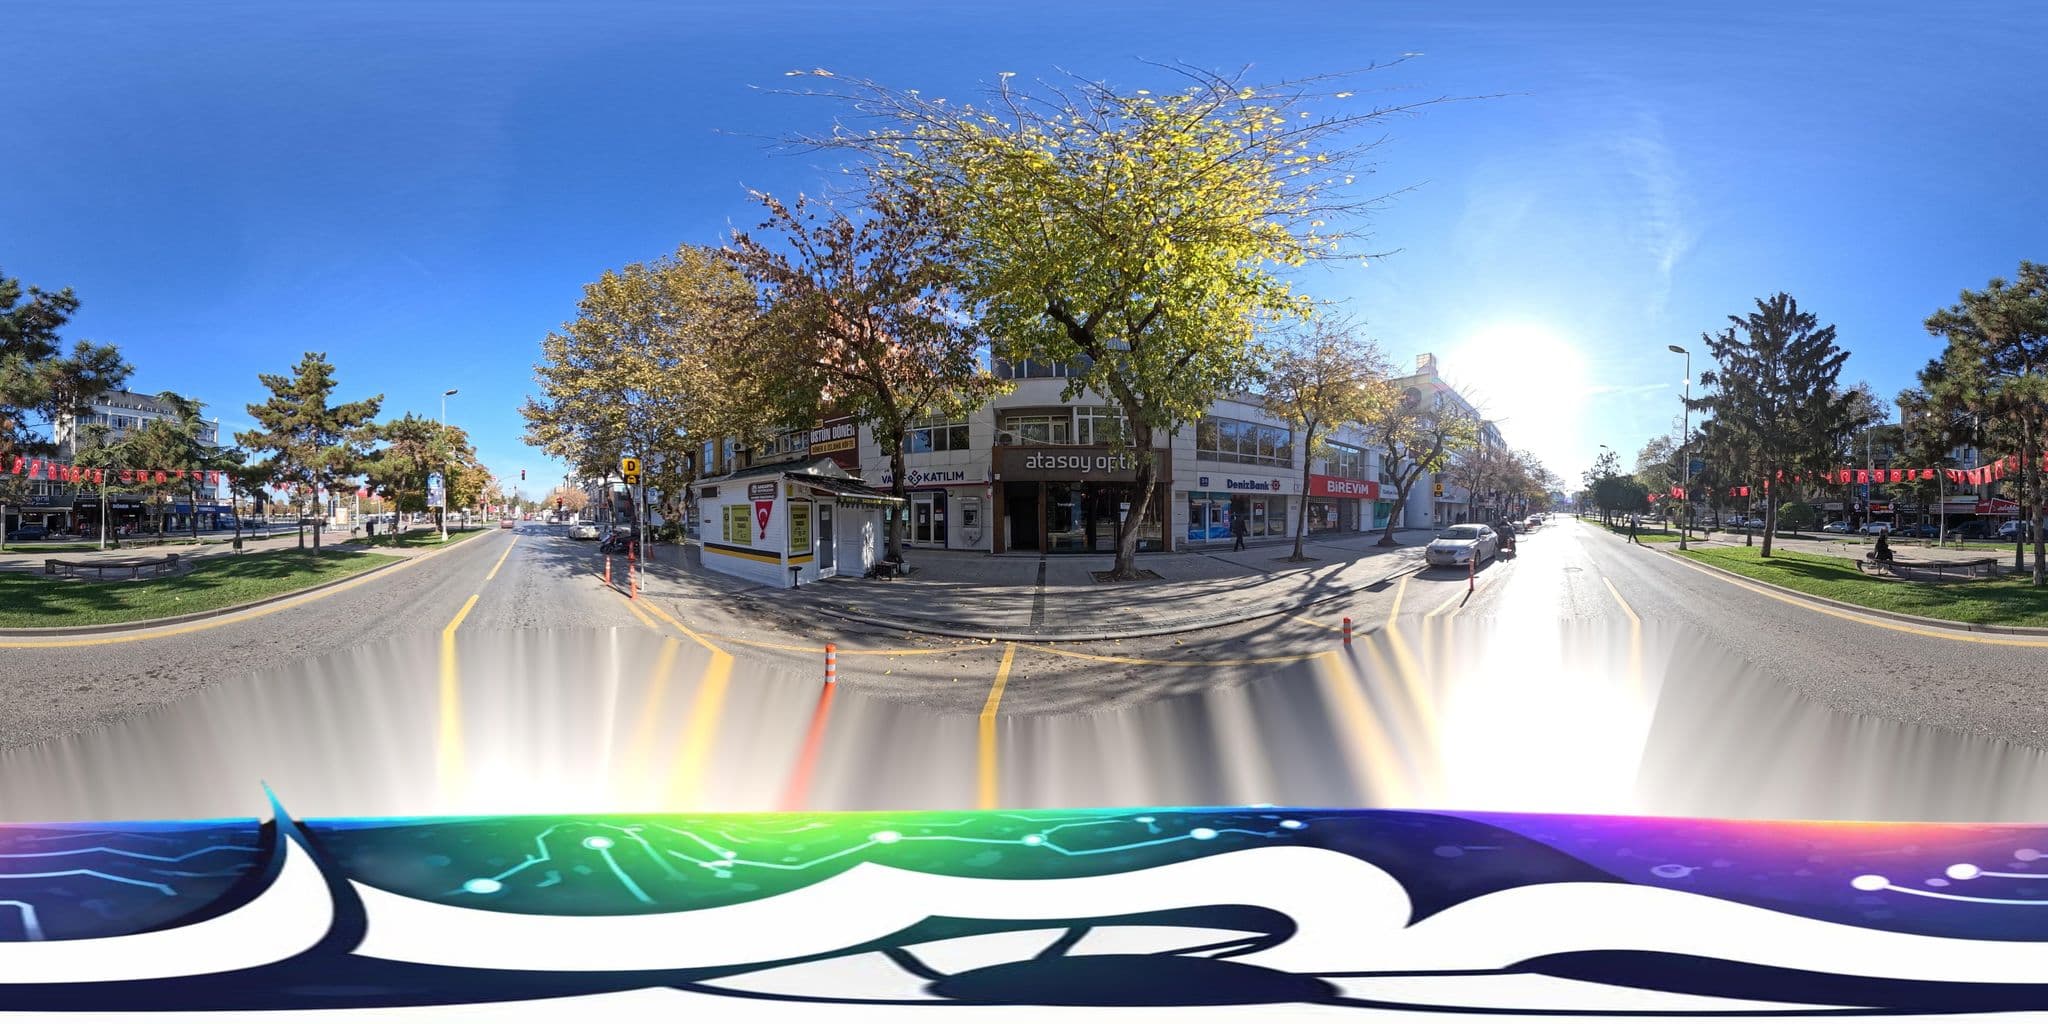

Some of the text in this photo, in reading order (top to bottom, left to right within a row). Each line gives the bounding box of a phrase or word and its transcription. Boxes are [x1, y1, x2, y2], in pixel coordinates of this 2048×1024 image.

[628, 461, 635, 471] D
[1026, 452, 1091, 473] atasoy
[924, 471, 964, 482] KATILIM
[1227, 479, 1269, 491] DenizBank
